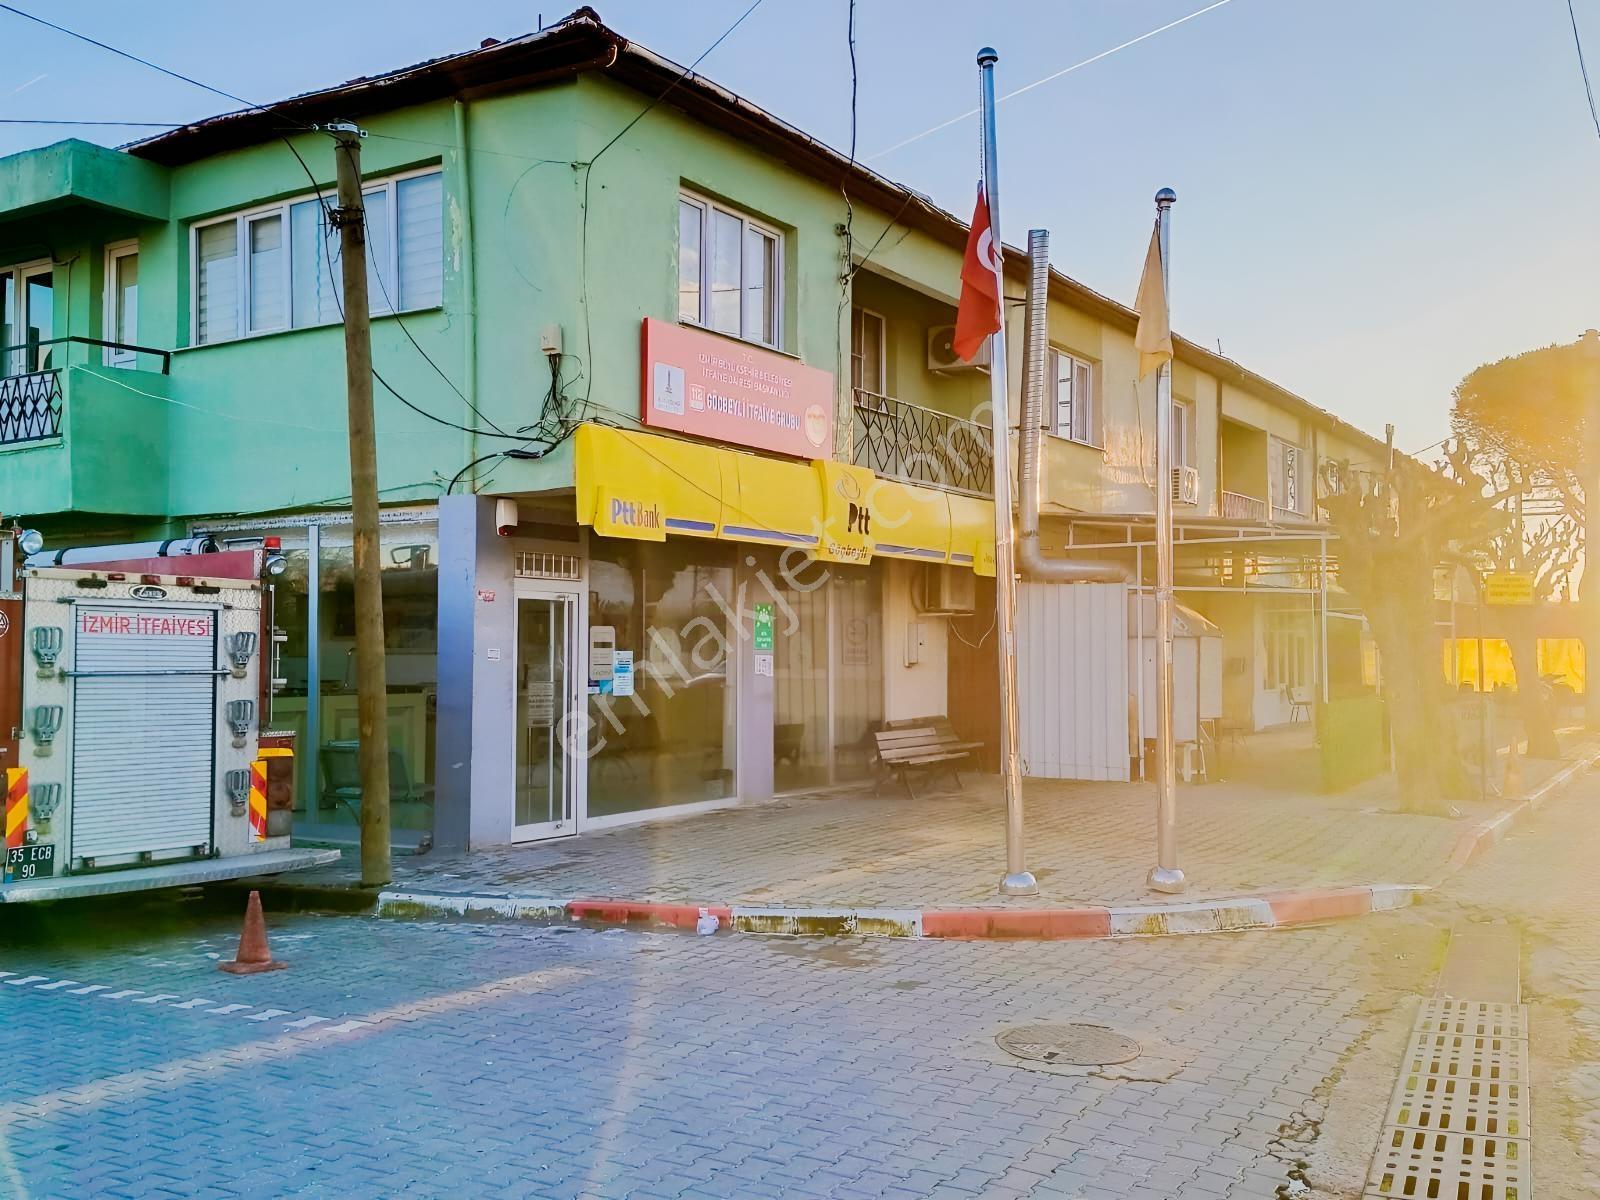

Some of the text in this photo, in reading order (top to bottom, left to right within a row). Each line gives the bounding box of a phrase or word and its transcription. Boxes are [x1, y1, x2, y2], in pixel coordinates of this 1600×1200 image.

[847, 502, 871, 535] Ptt
[83, 612, 210, 637] İZMİR İTFAİYESİ
[10, 846, 52, 863] 35 ECB
[22, 863, 36, 878] 90
